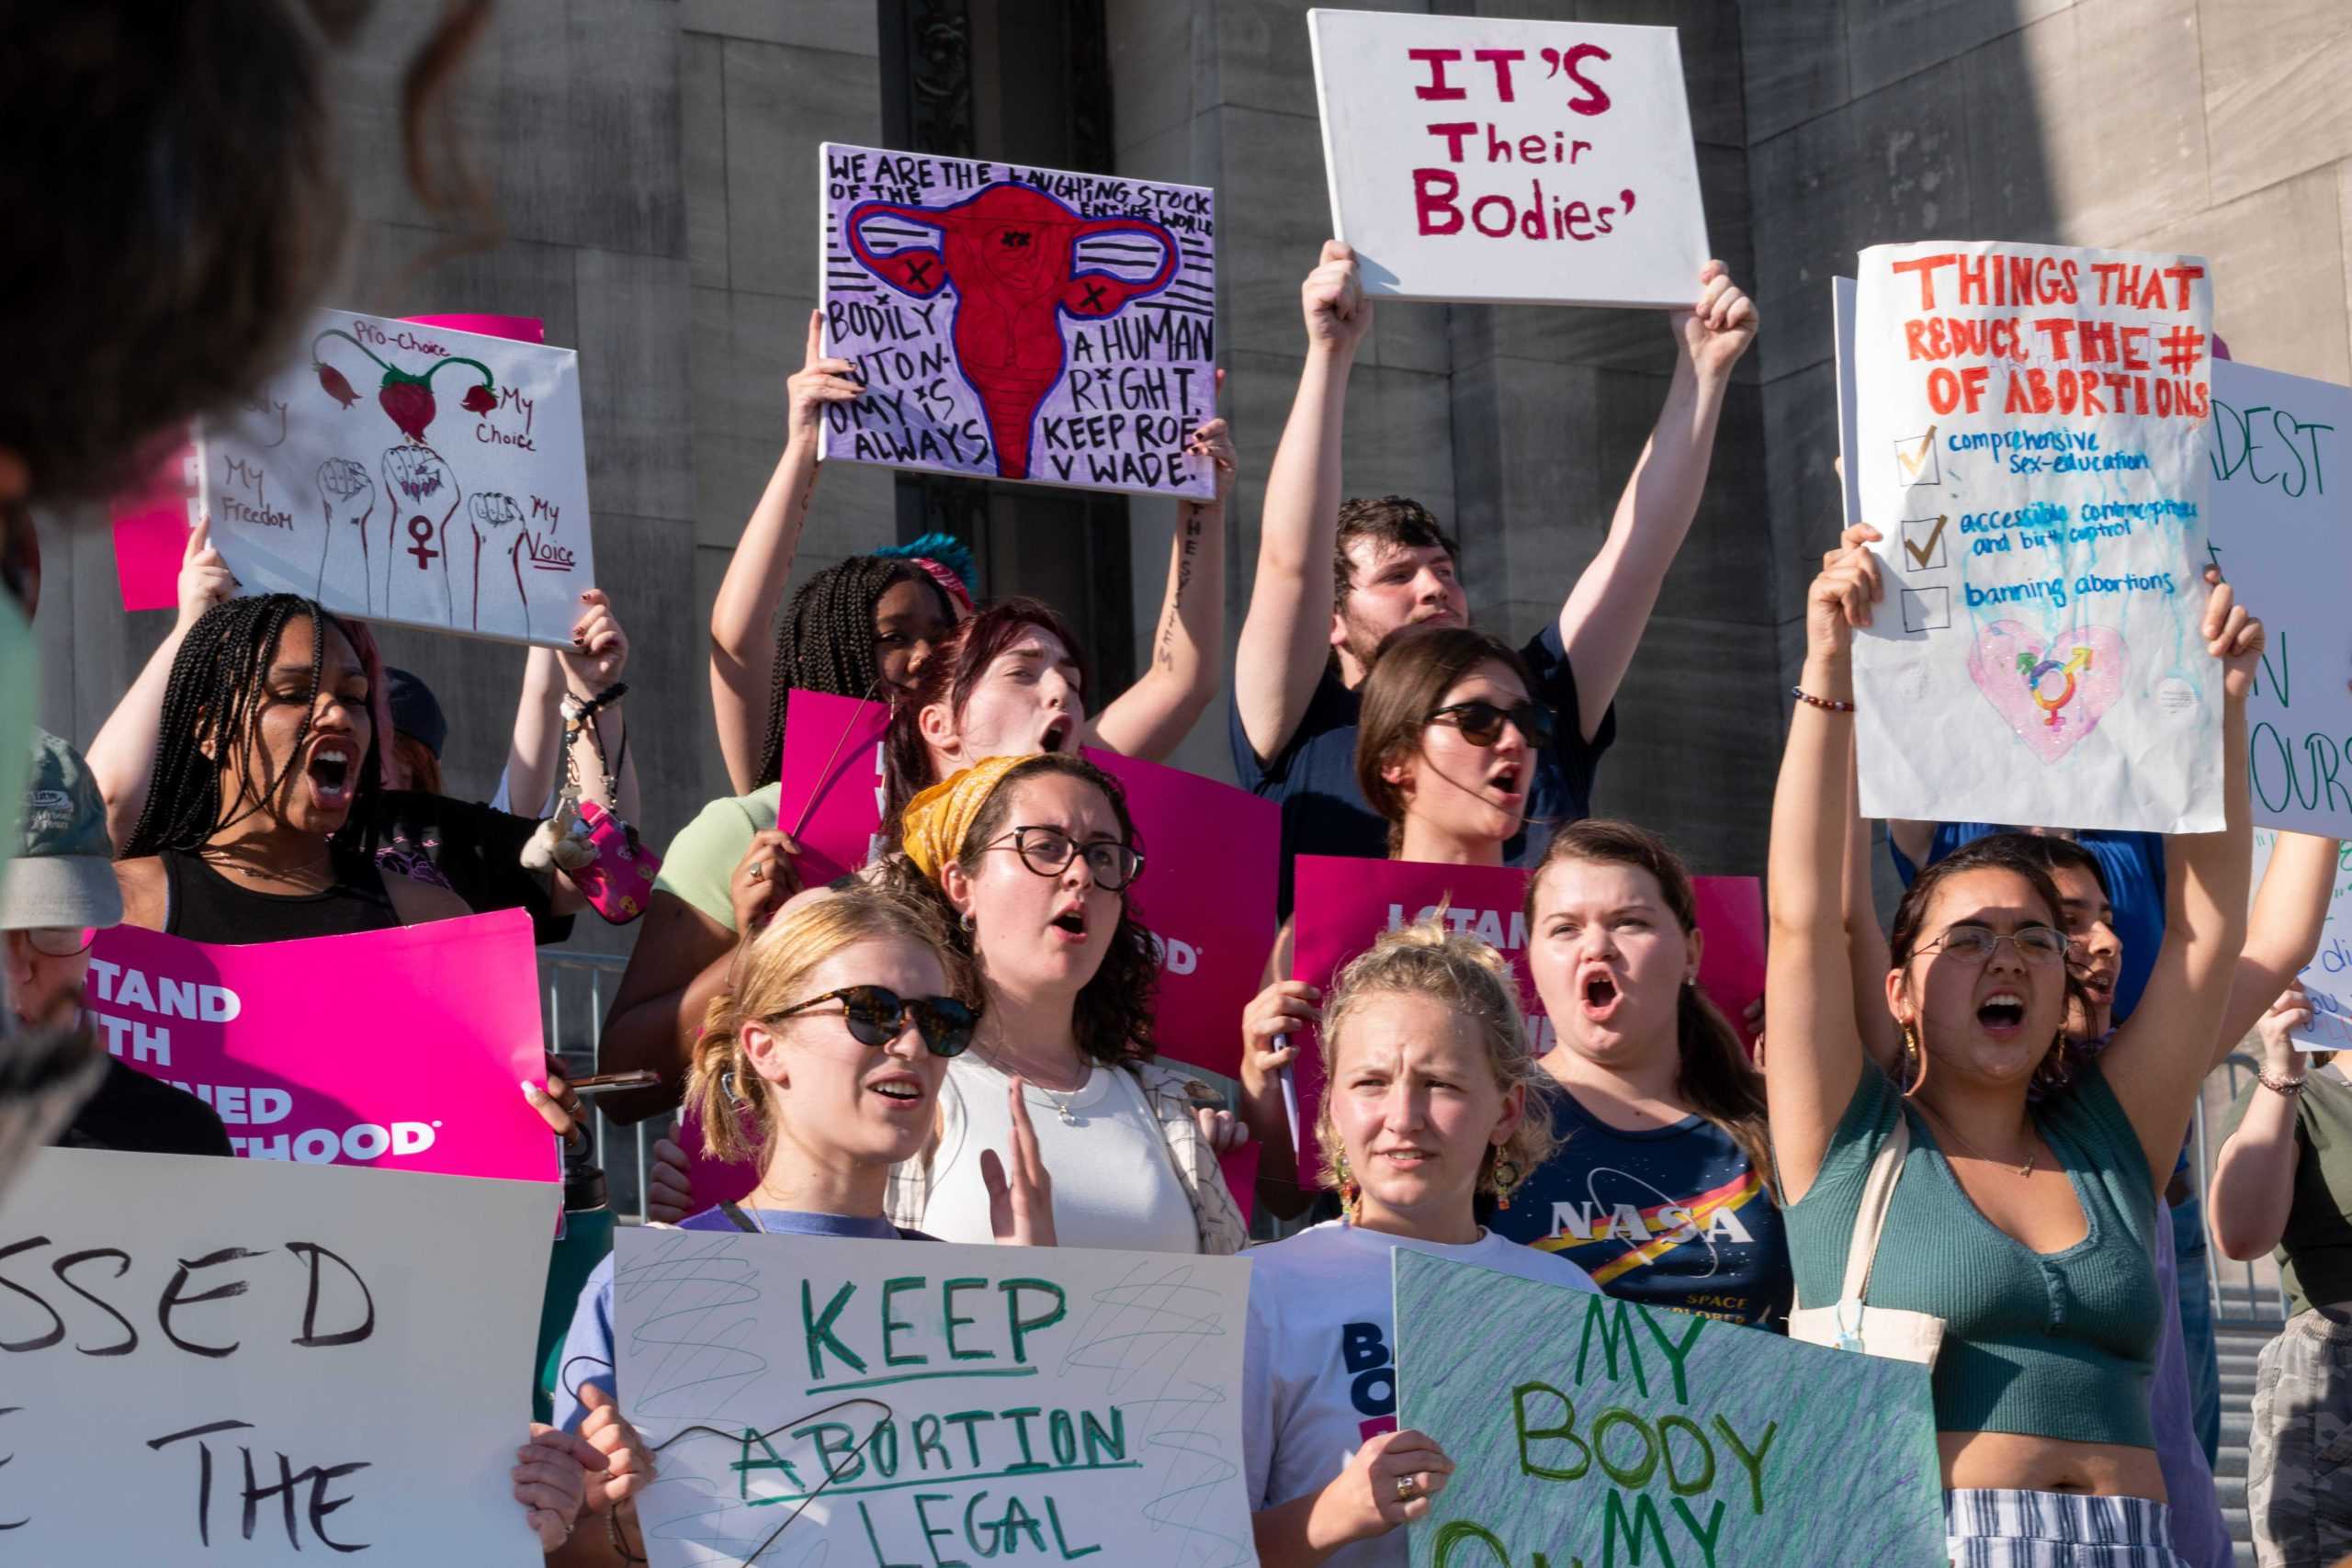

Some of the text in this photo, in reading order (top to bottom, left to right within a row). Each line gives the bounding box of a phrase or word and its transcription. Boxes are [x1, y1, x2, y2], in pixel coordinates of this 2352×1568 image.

[1408, 43, 1611, 116] IT'S
[1426, 122, 1592, 164] Their
[829, 153, 866, 183] WE
[875, 155, 934, 189] ARE
[938, 162, 991, 190] THE
[1137, 186, 1211, 215] STOCK
[831, 184, 860, 200] OF
[869, 185, 922, 205] THE
[1412, 168, 1636, 242] Bodies'
[1893, 254, 2204, 311] THINGS THAT
[1073, 309, 1214, 363] A HUMAN
[1905, 317, 2205, 376] REDUCE THE #
[500, 386, 533, 435] My
[828, 389, 906, 434] OMY
[1928, 366, 2209, 419] OF ABORTIONS
[476, 423, 537, 452] Choice
[855, 419, 989, 466] ALWAYS
[1043, 413, 1201, 453] KEEP ROE
[1949, 427, 2100, 463] comprehensive
[224, 455, 264, 508] My
[1051, 452, 1196, 488] V WADE.
[530, 495, 559, 535] My
[526, 529, 575, 566] Voice
[1973, 533, 2011, 556] and
[1964, 572, 2176, 608] banning abortions
[85, 957, 241, 1023] TAND
[88, 1009, 171, 1066] TH
[1550, 1201, 1755, 1245] NASA
[802, 1276, 1068, 1381] KEEP
[1575, 1293, 1707, 1405] MY
[729, 1404, 1125, 1500] ABORTION
[1512, 1381, 1777, 1515] BODY
[147, 1419, 372, 1552] THE
[858, 1490, 1102, 1568] LEGAL
[1602, 1487, 1725, 1568] MY
